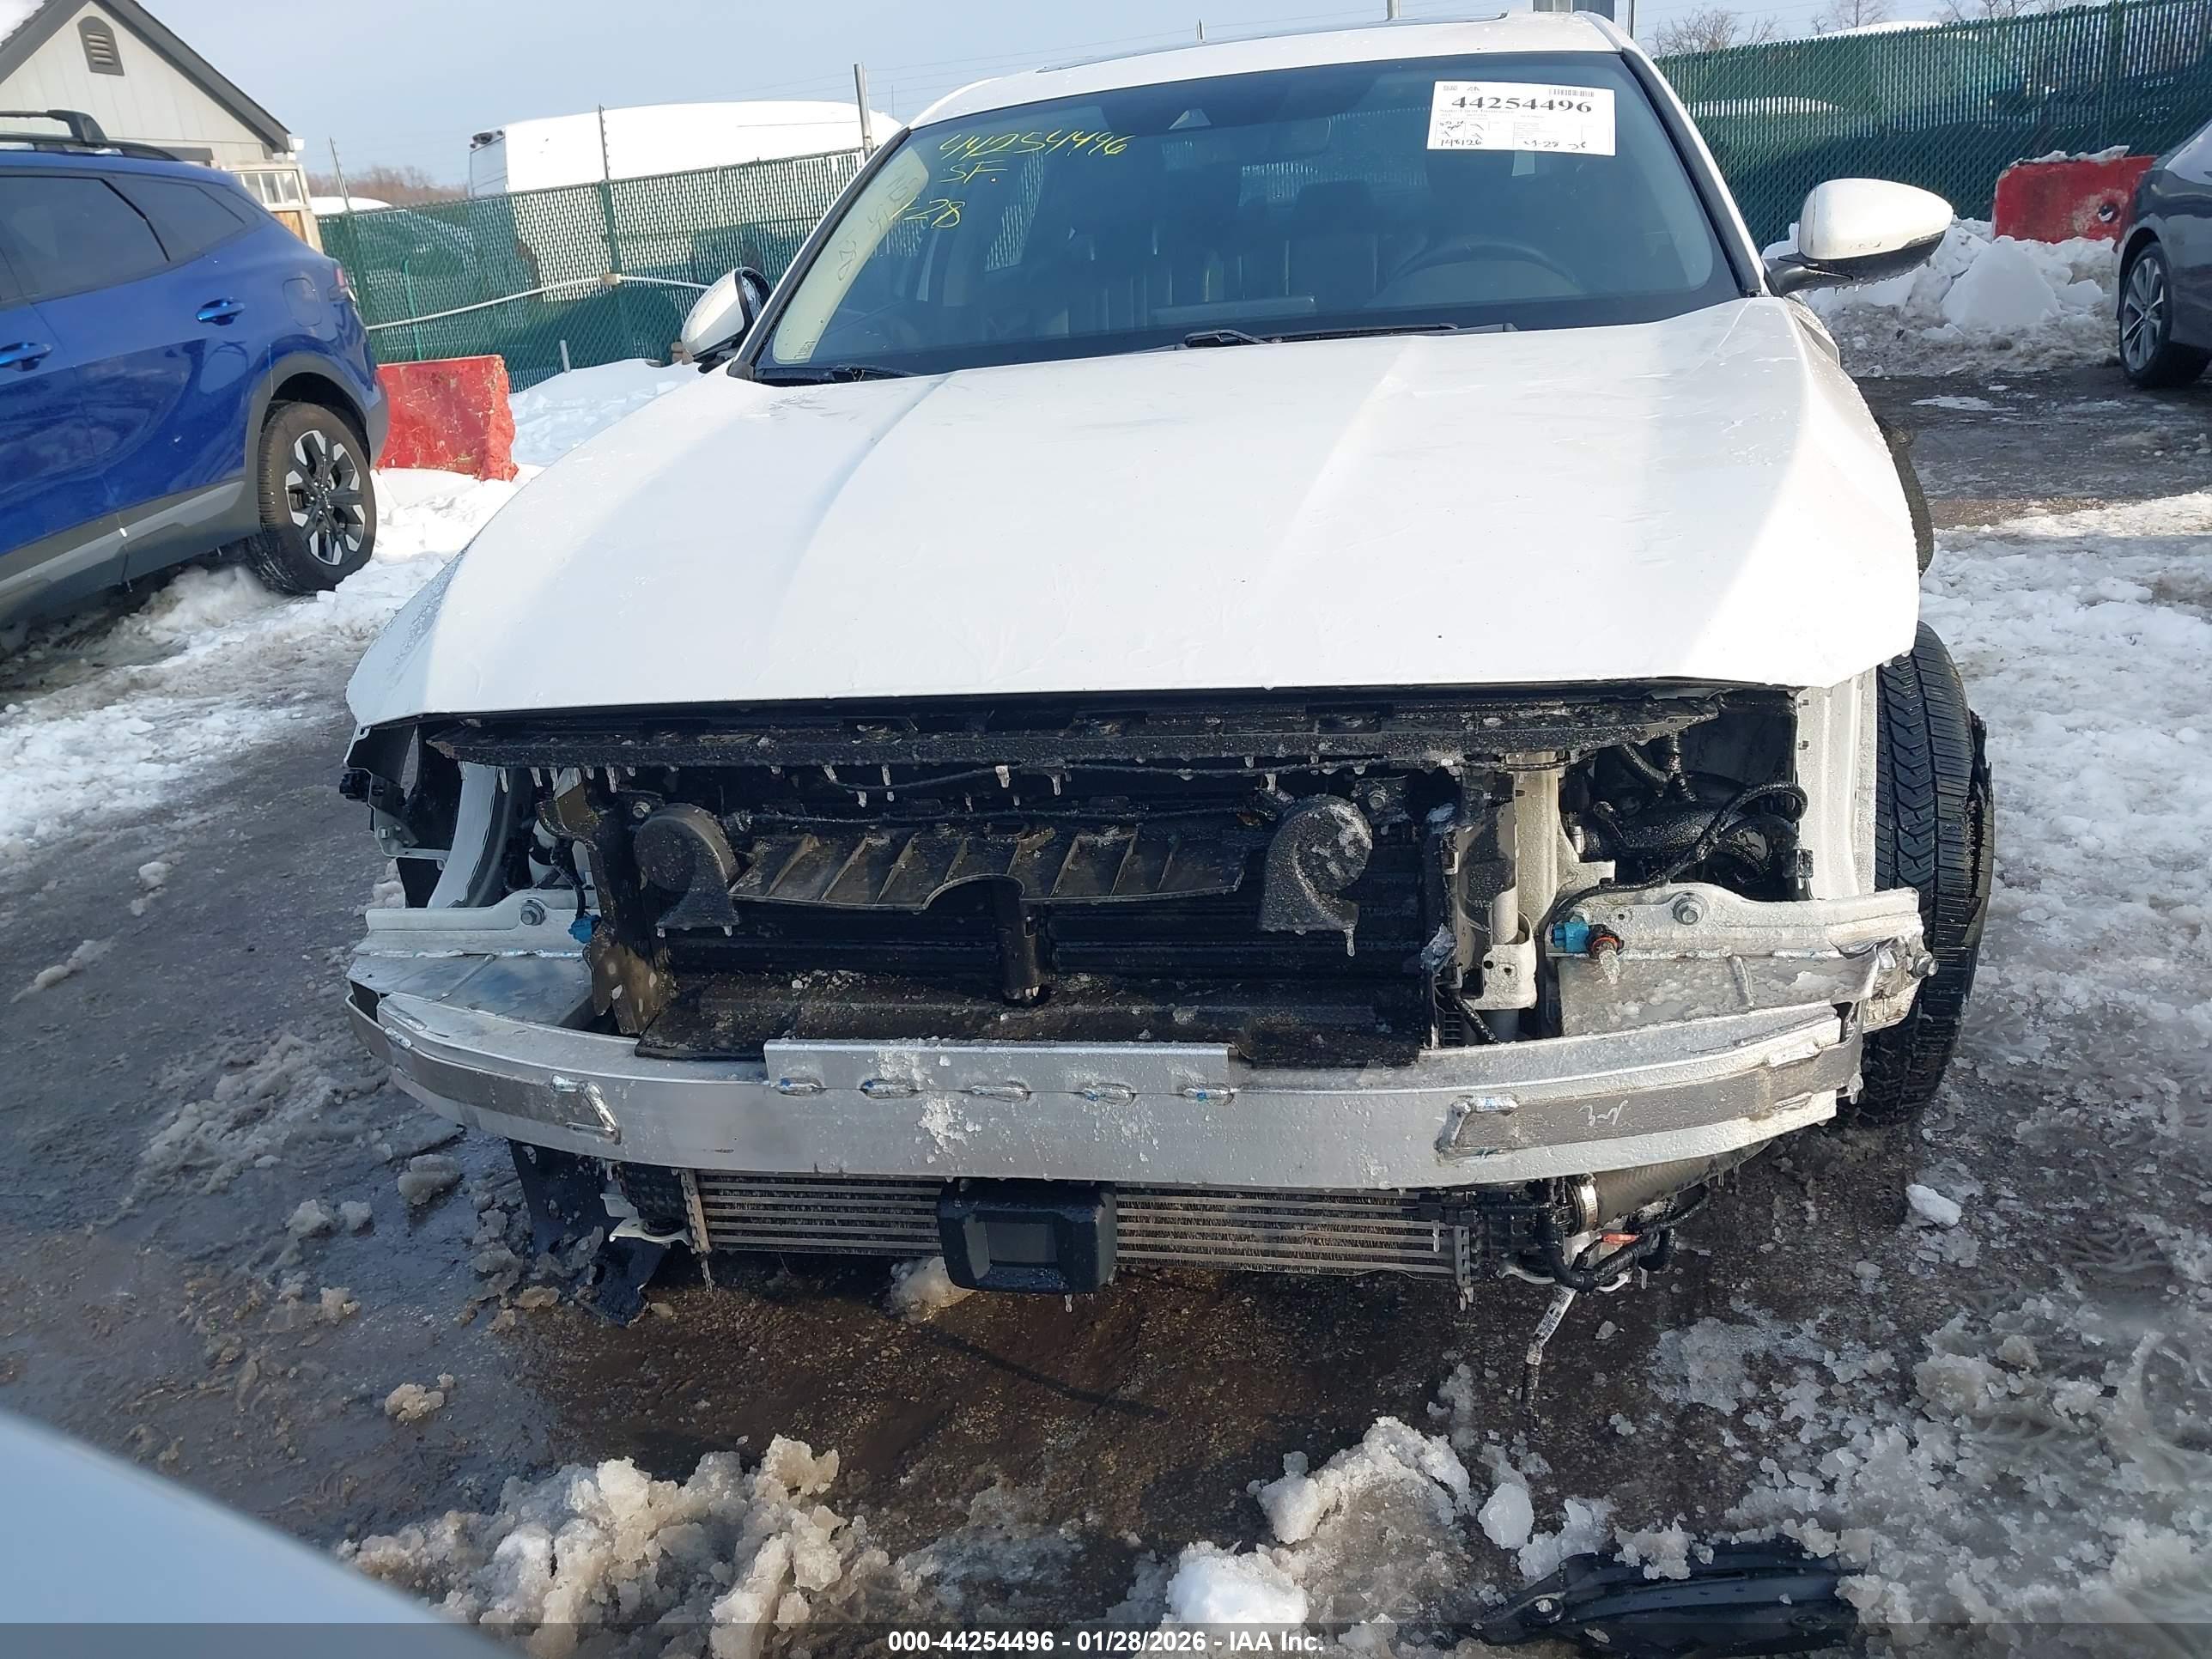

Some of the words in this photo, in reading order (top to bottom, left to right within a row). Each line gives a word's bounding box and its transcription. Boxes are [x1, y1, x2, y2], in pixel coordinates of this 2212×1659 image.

[1451, 96, 1592, 113] 44254496
[939, 129, 1136, 161] 44254496
[889, 196, 966, 229] 1-28
